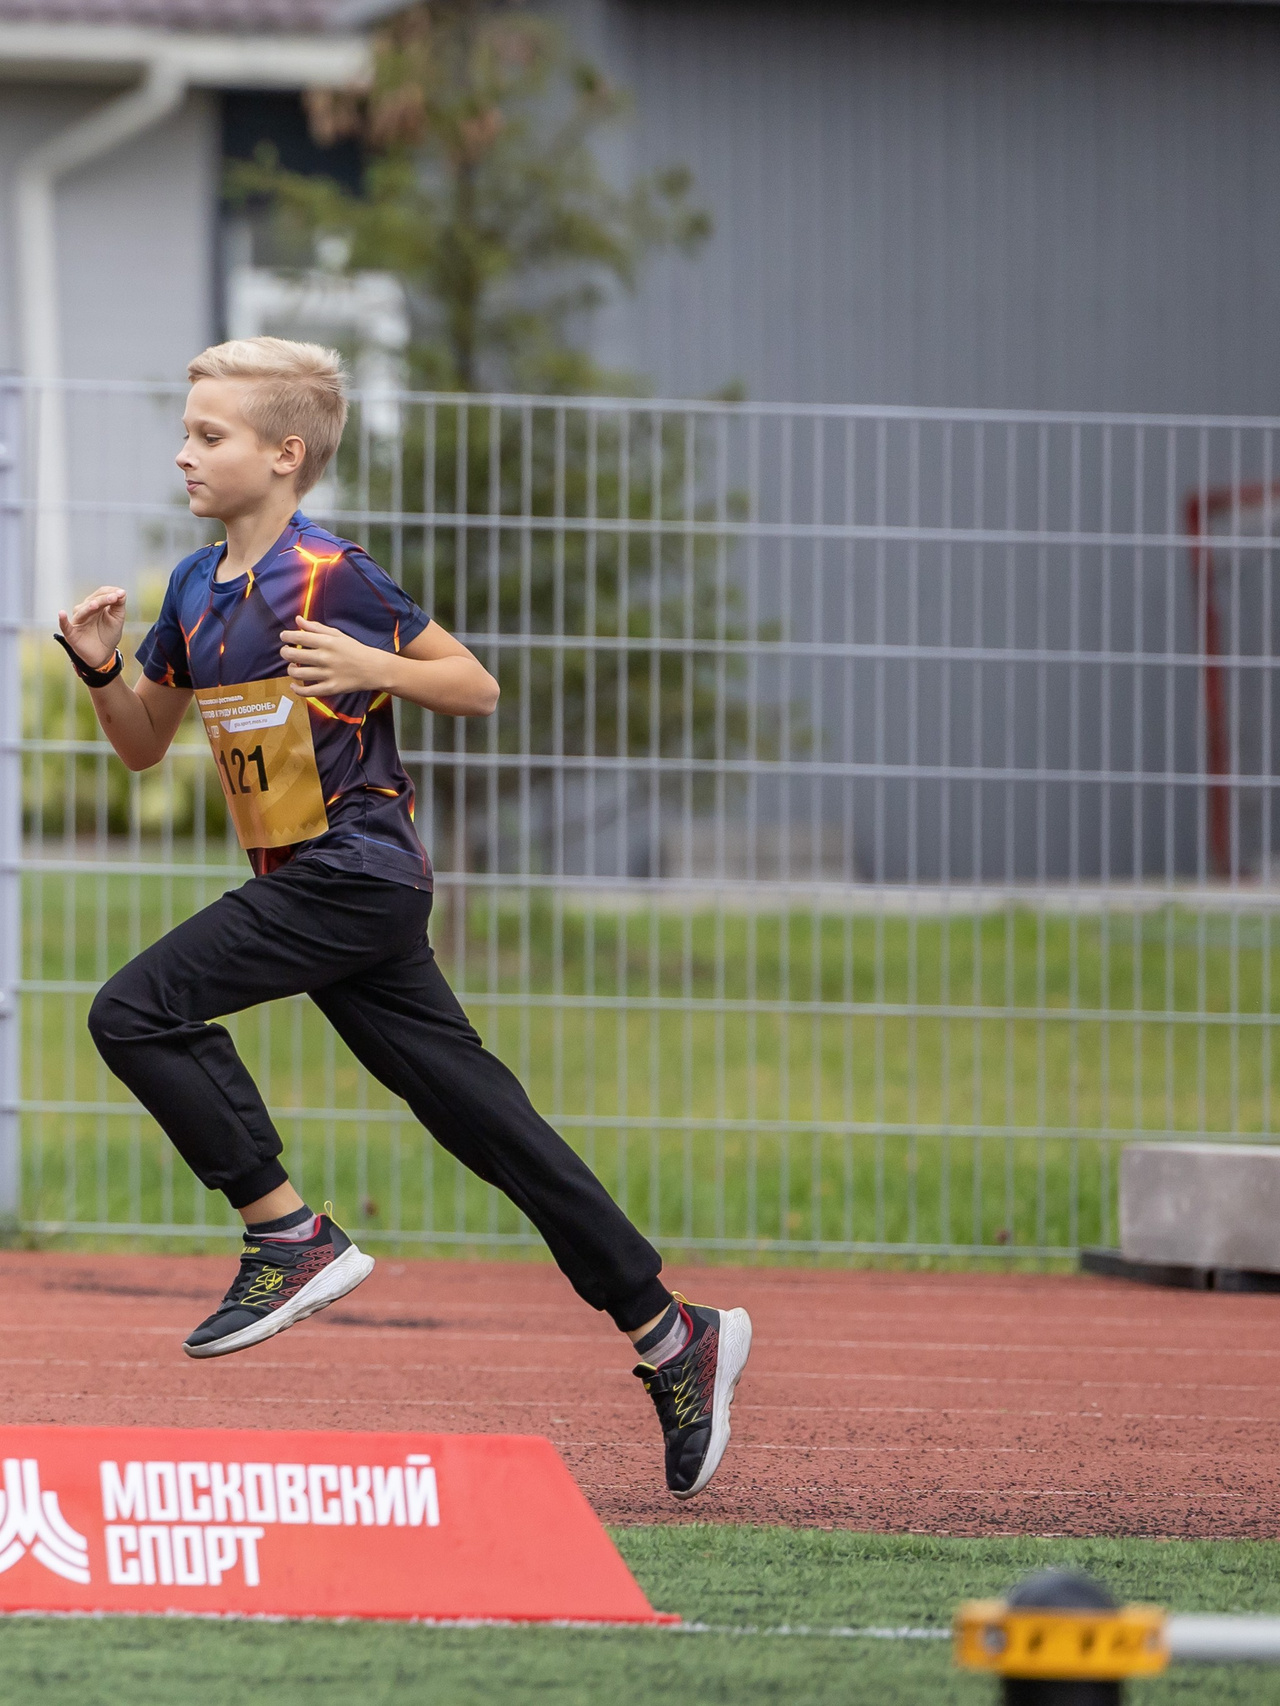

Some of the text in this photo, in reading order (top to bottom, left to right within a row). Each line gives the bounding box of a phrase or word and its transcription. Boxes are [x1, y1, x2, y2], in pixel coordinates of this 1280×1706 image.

[232, 708, 238, 716] И
[99, 1453, 441, 1527] МОСКОВСКИЙ
[103, 1525, 265, 1587] СПОРТ
